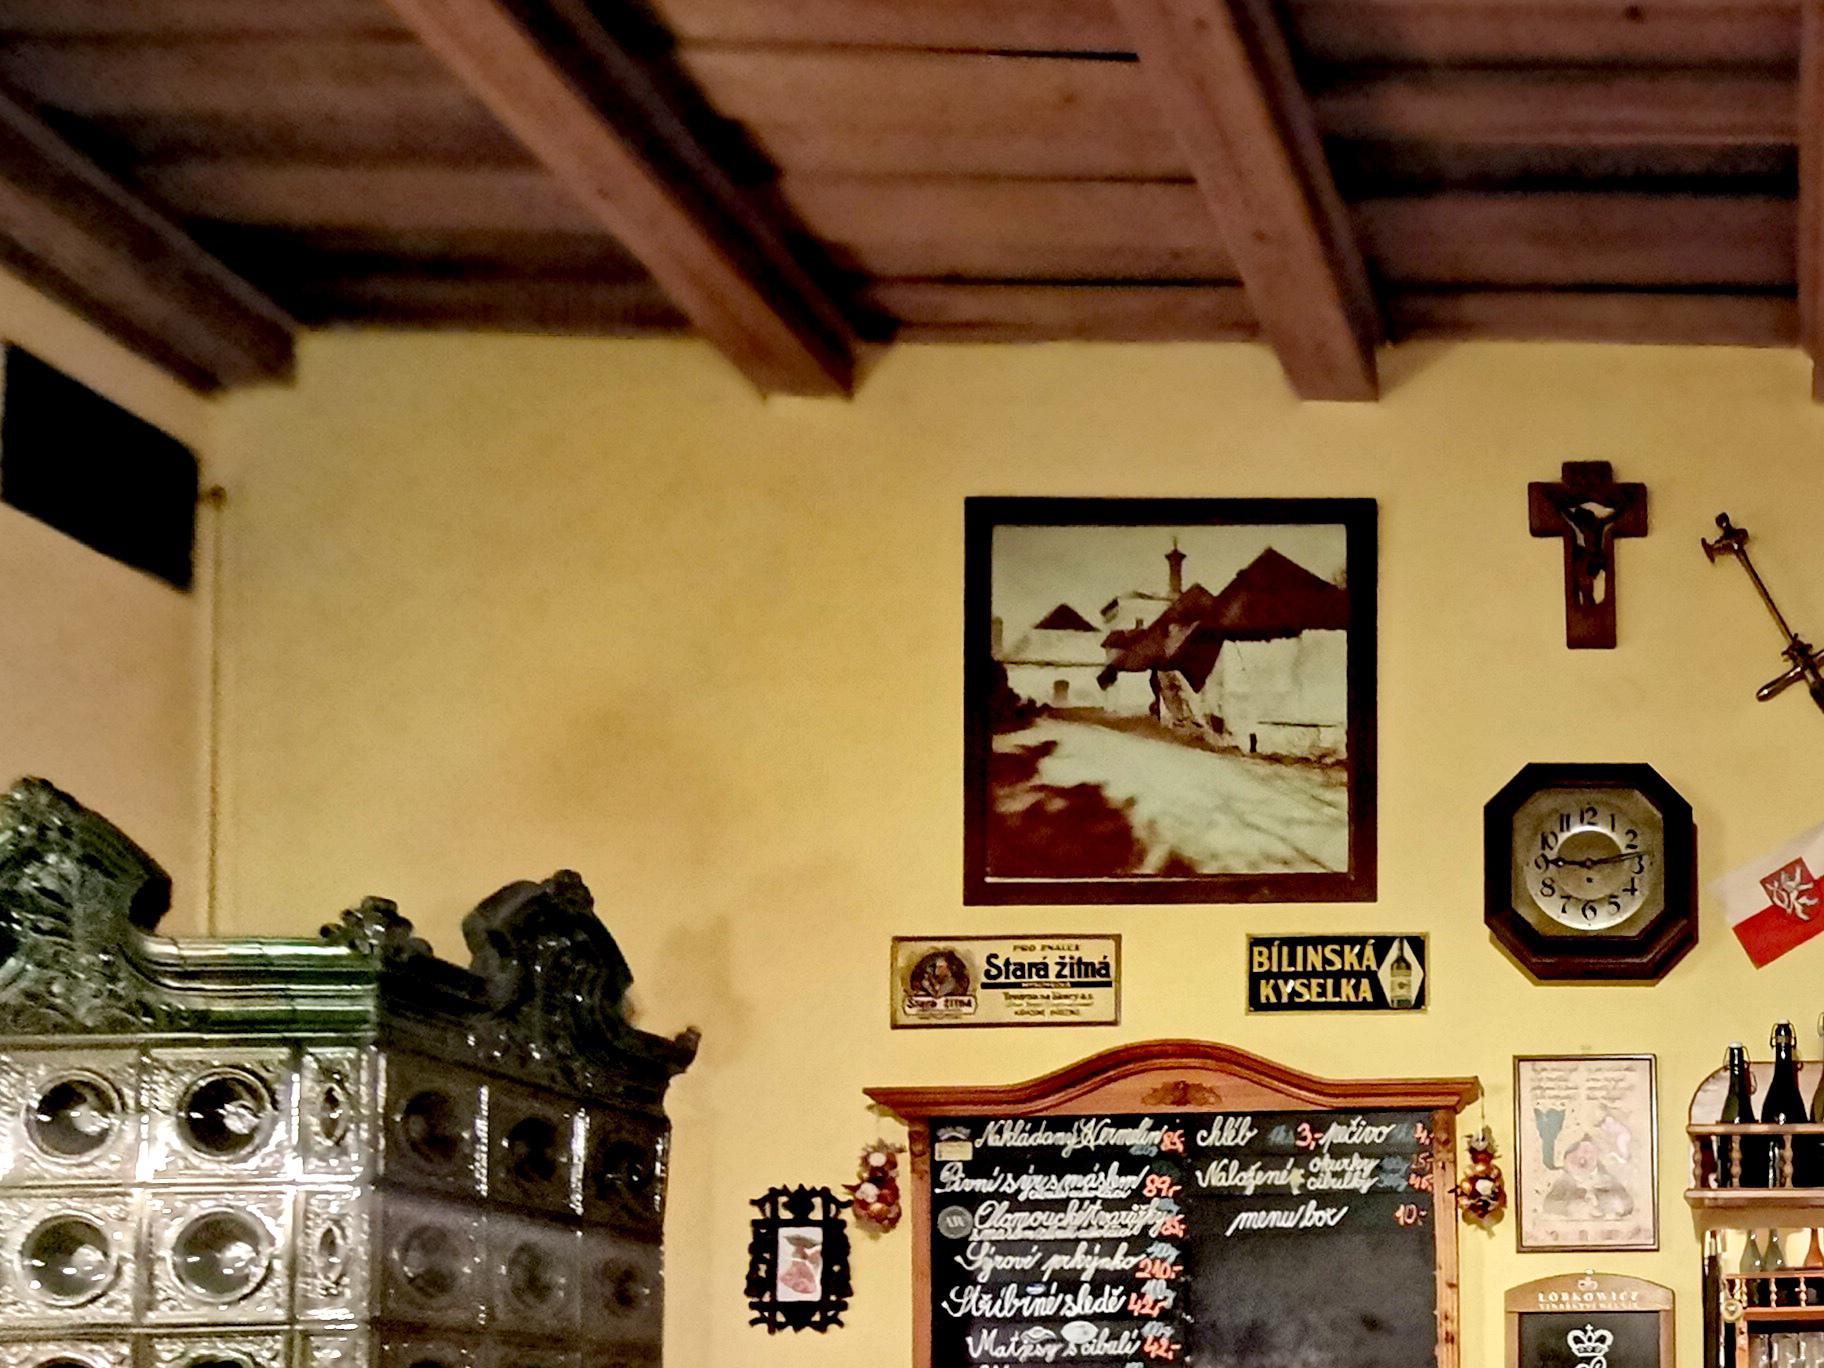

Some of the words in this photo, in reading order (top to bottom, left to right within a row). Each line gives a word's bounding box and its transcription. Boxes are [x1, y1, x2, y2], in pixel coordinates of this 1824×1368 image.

[1559, 813, 1571, 833] 11
[1580, 806, 1598, 826] 12
[1610, 813, 1616, 832] 1
[1541, 831, 1558, 851] 10
[1625, 829, 1638, 850] 2
[1535, 853, 1550, 871] 9
[1632, 855, 1644, 874] 3
[1540, 877, 1556, 897] 8
[1622, 877, 1638, 896] 4
[1560, 895, 1572, 914] 7
[1582, 900, 1597, 920] 6
[1608, 895, 1621, 914] 5
[1252, 939, 1379, 973] BÍLINSKÁ
[984, 953, 1049, 981] Stará
[1055, 955, 1111, 979] žitná
[1260, 978, 1373, 1003] KYSELKA
